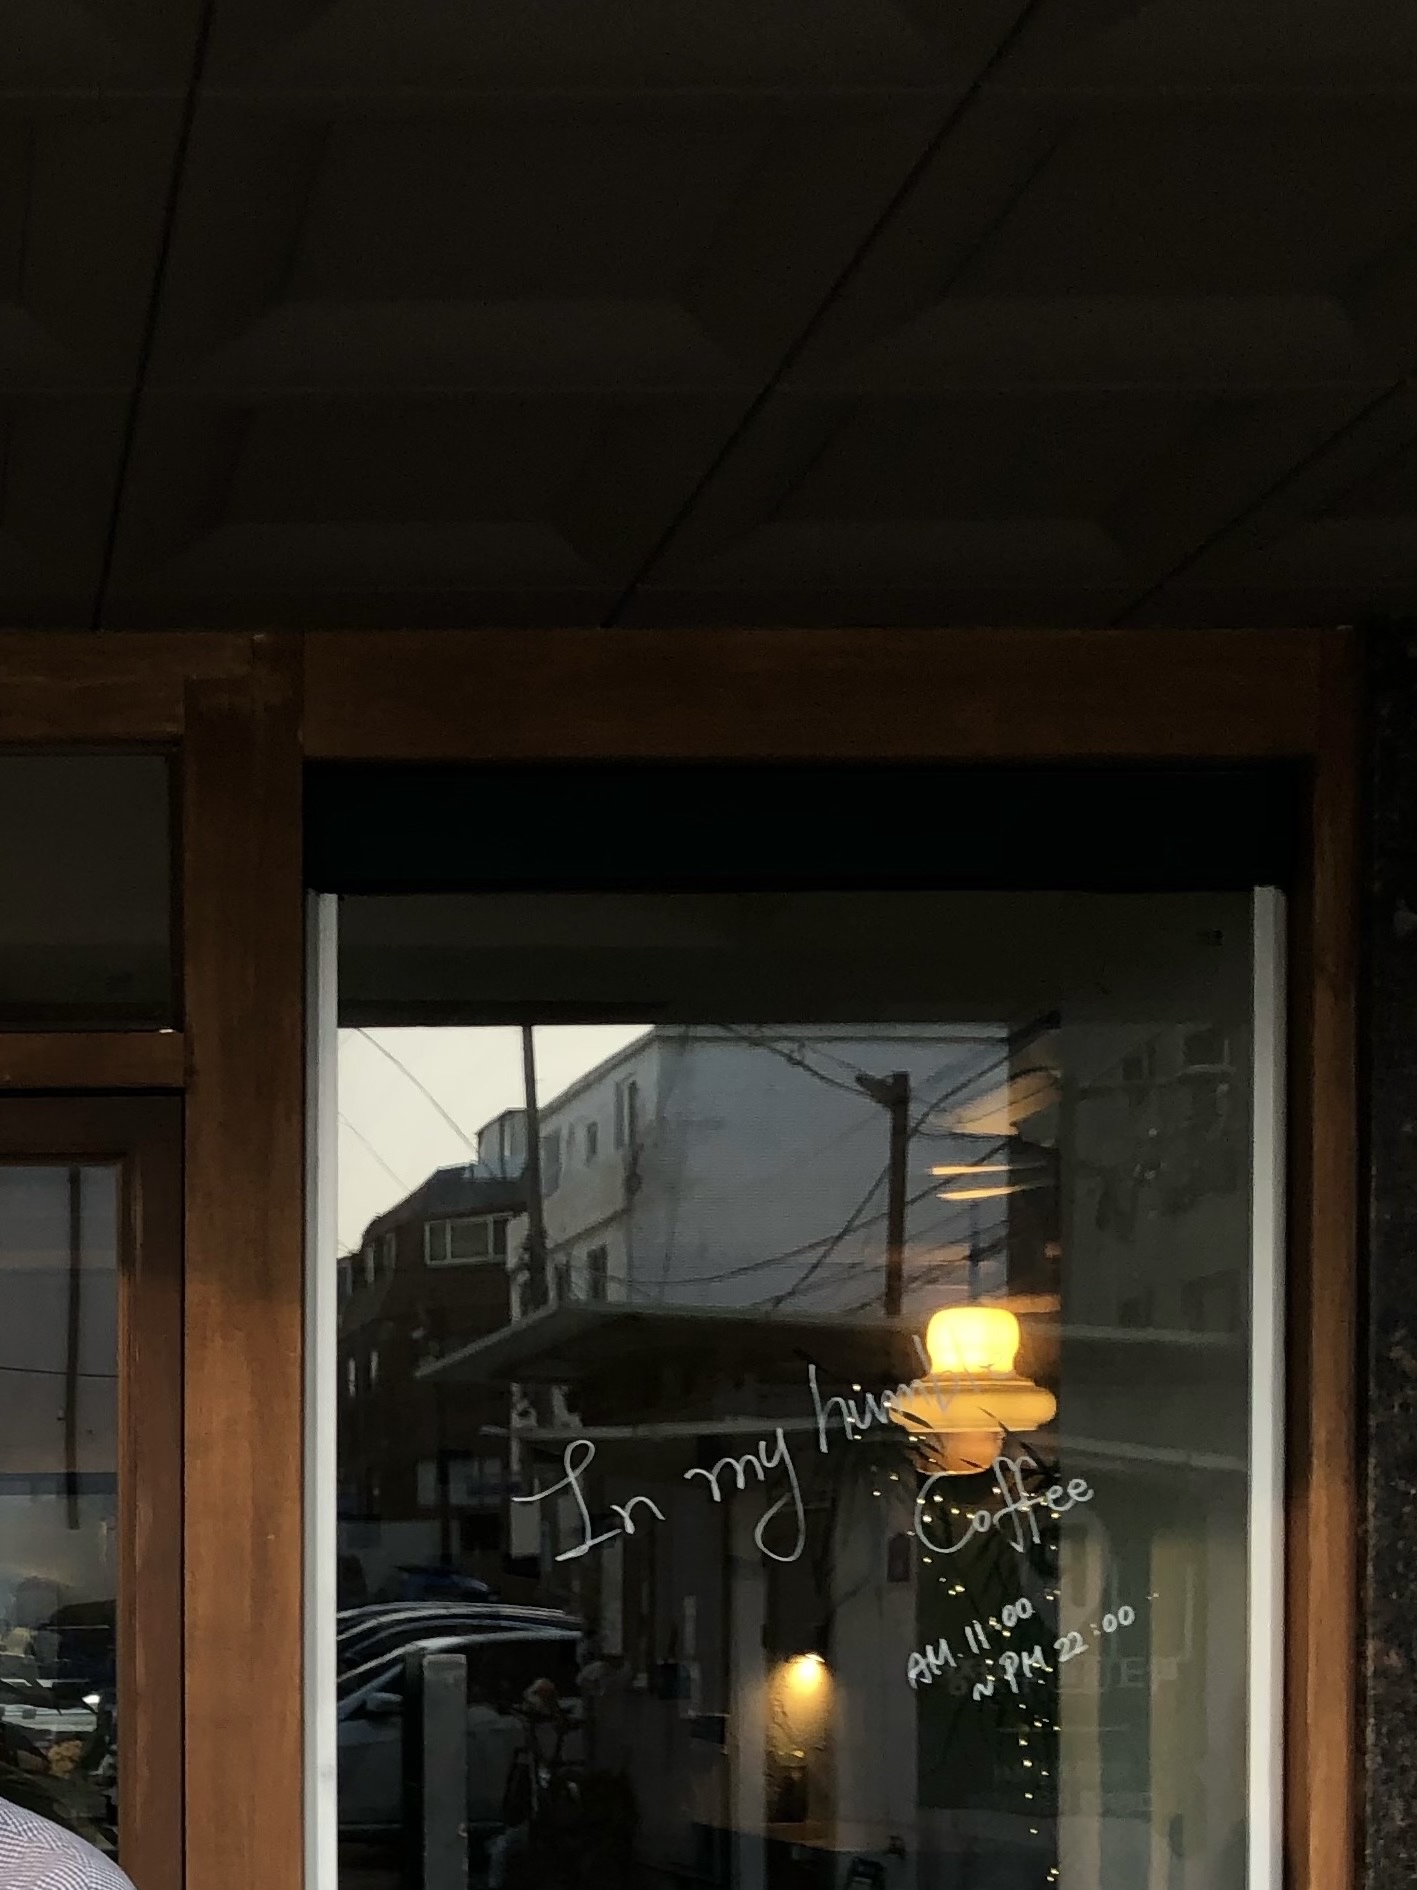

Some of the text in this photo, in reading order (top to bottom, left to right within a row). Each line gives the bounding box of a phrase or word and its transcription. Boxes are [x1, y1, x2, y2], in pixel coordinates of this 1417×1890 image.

[511, 1439, 667, 1561] In
[683, 1427, 806, 1562] my
[913, 1456, 1095, 1554] Coffee
[998, 1645, 1048, 1694] PM
[1053, 1605, 1136, 1663] 22:00
